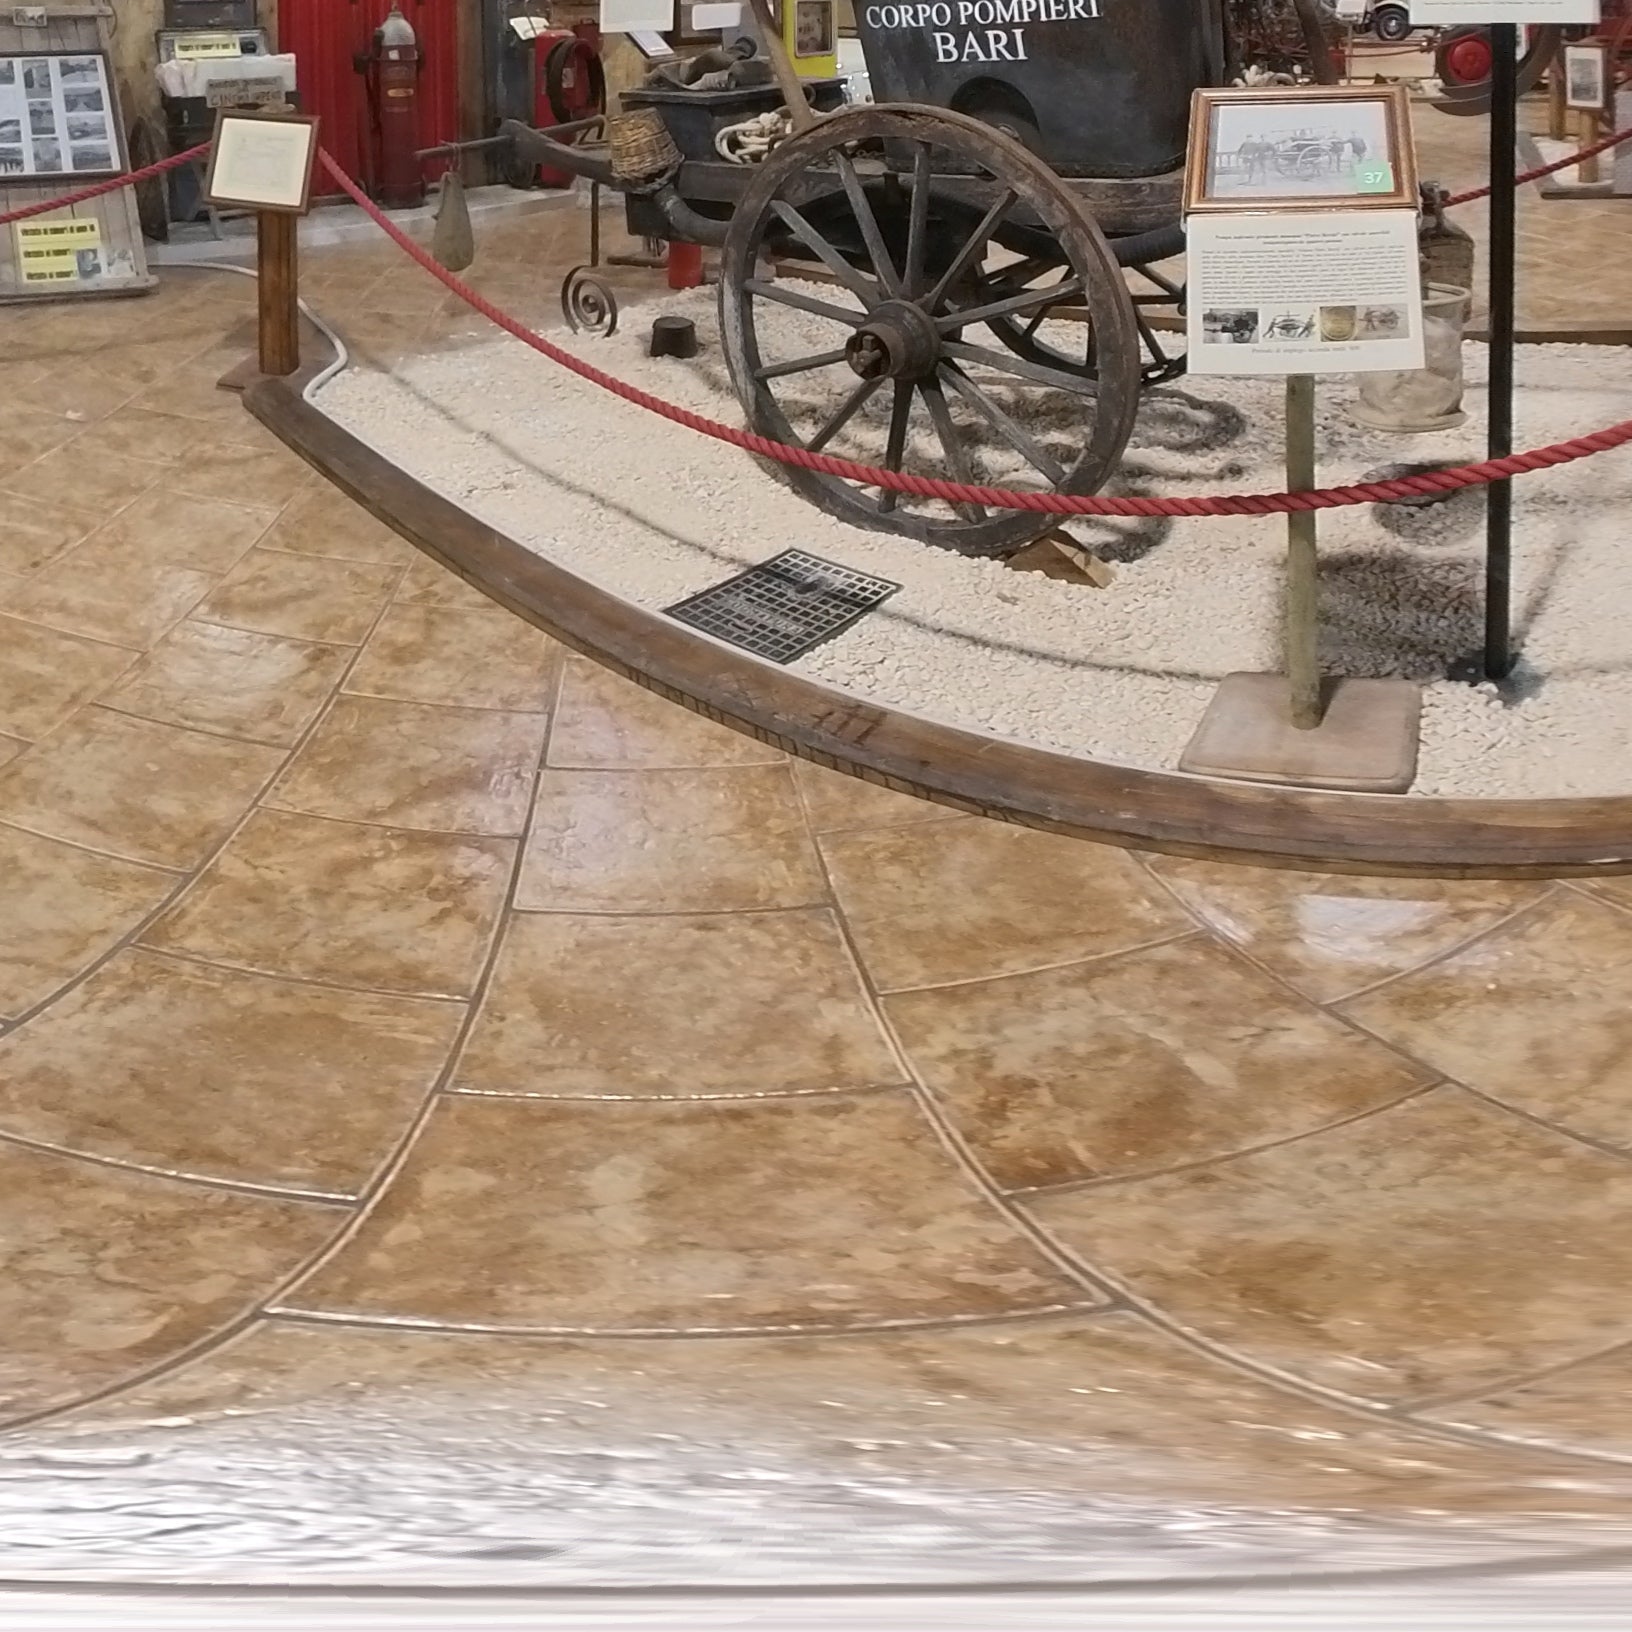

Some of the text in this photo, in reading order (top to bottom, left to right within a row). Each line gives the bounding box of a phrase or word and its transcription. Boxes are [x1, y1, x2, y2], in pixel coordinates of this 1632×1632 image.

[865, 2, 951, 29] CORPO
[932, 28, 1029, 63] BARI
[1364, 171, 1384, 184] 37
